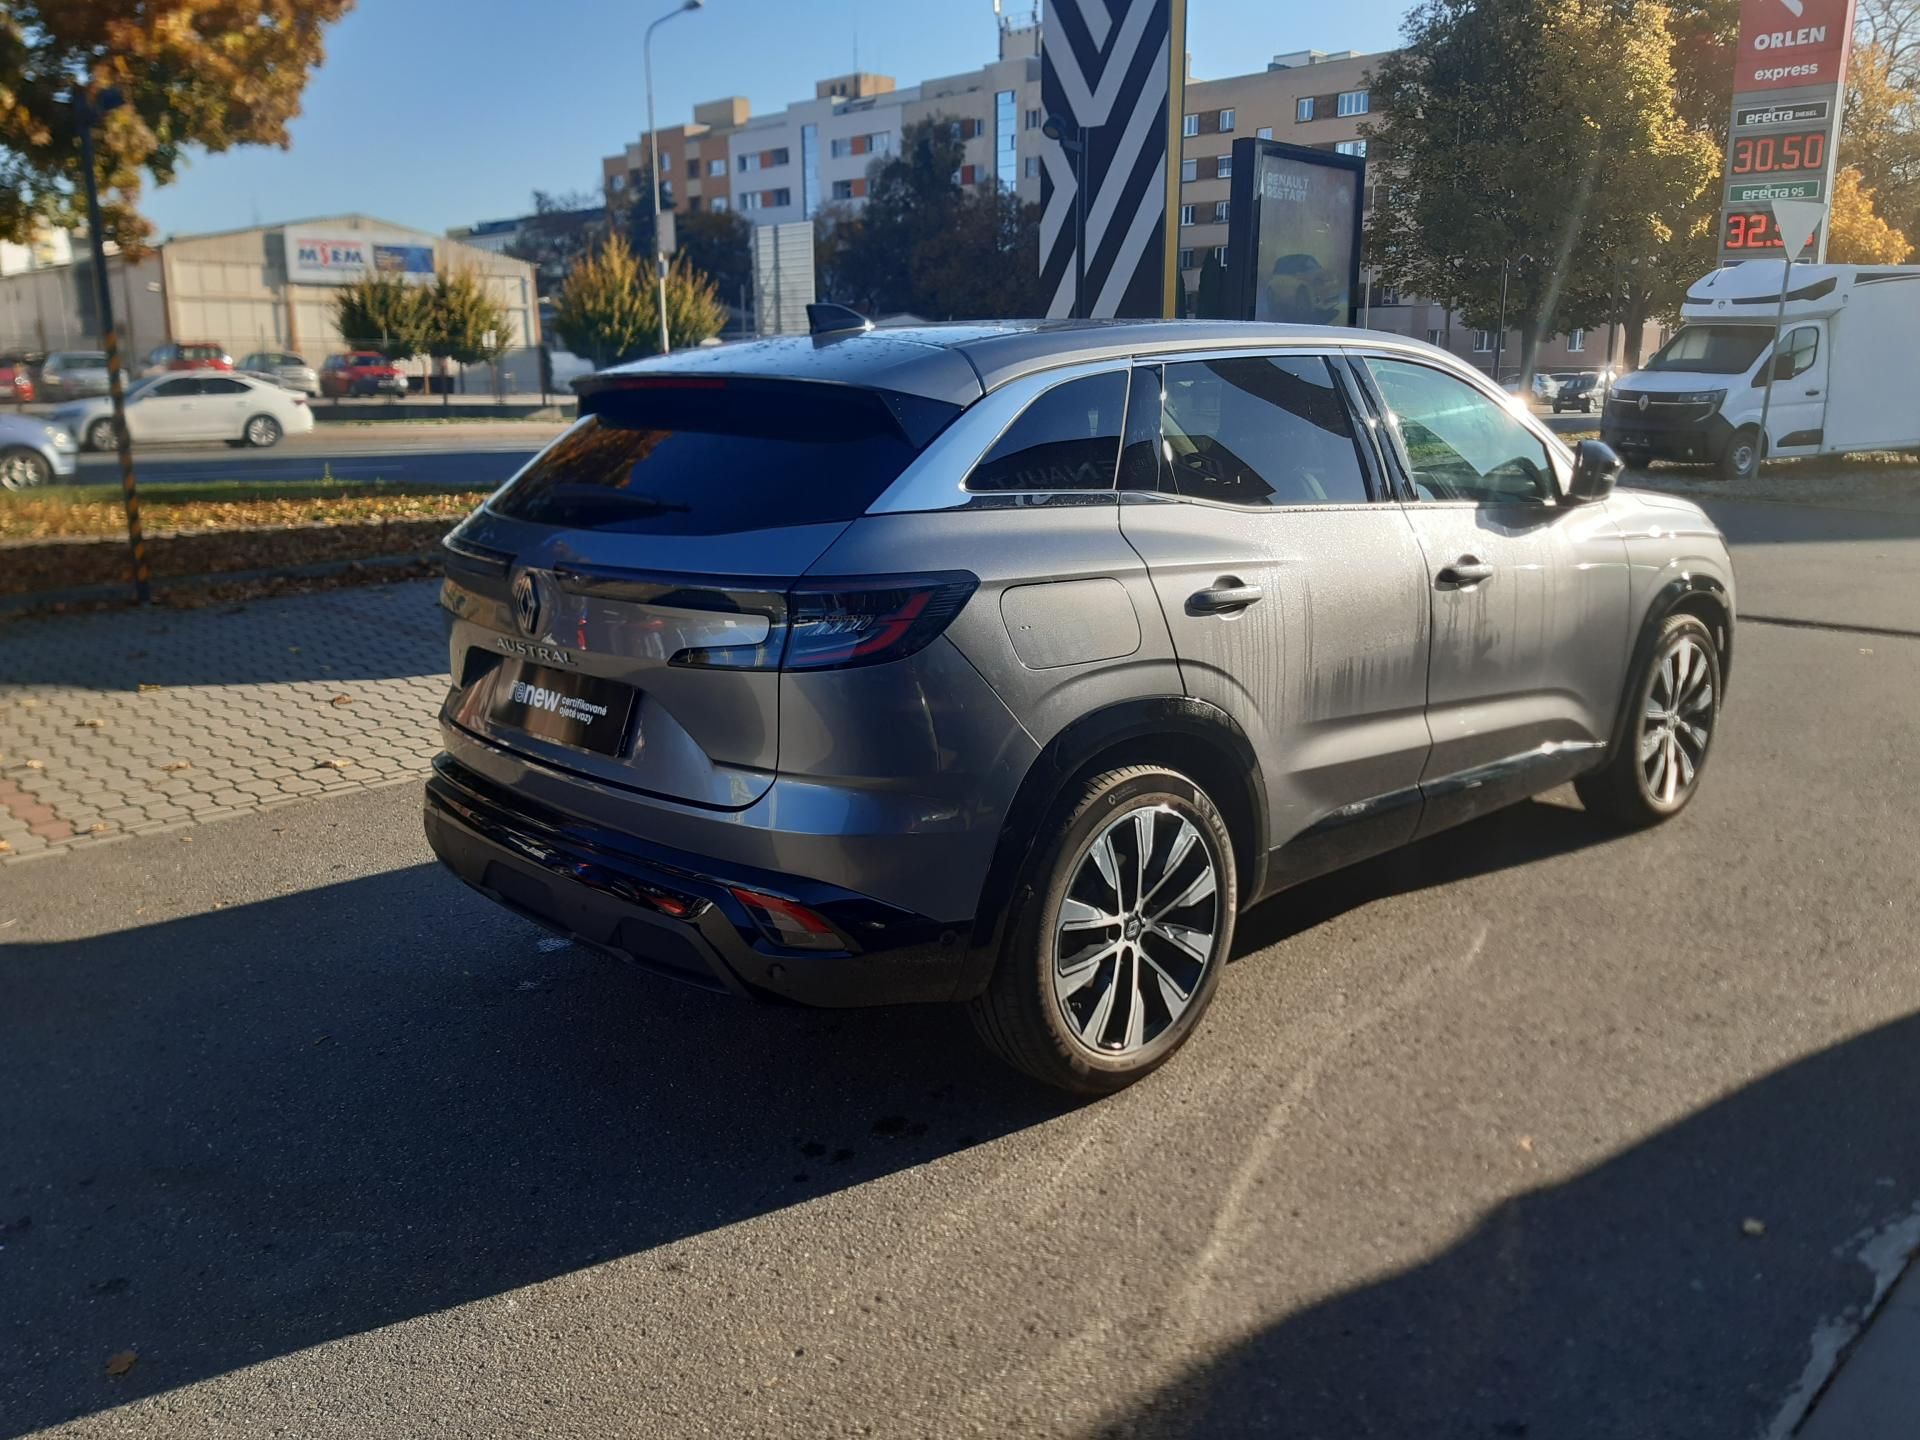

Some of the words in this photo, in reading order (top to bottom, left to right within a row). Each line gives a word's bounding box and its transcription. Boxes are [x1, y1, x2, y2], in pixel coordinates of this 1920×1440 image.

[1754, 26, 1826, 50] ORLEN
[1754, 63, 1818, 81] express
[1734, 134, 1825, 173] 30.50
[1267, 172, 1309, 189] RENAULT
[1791, 186, 1805, 197] 95
[497, 637, 578, 666] AUSTRAL
[561, 696, 608, 716] certifikované
